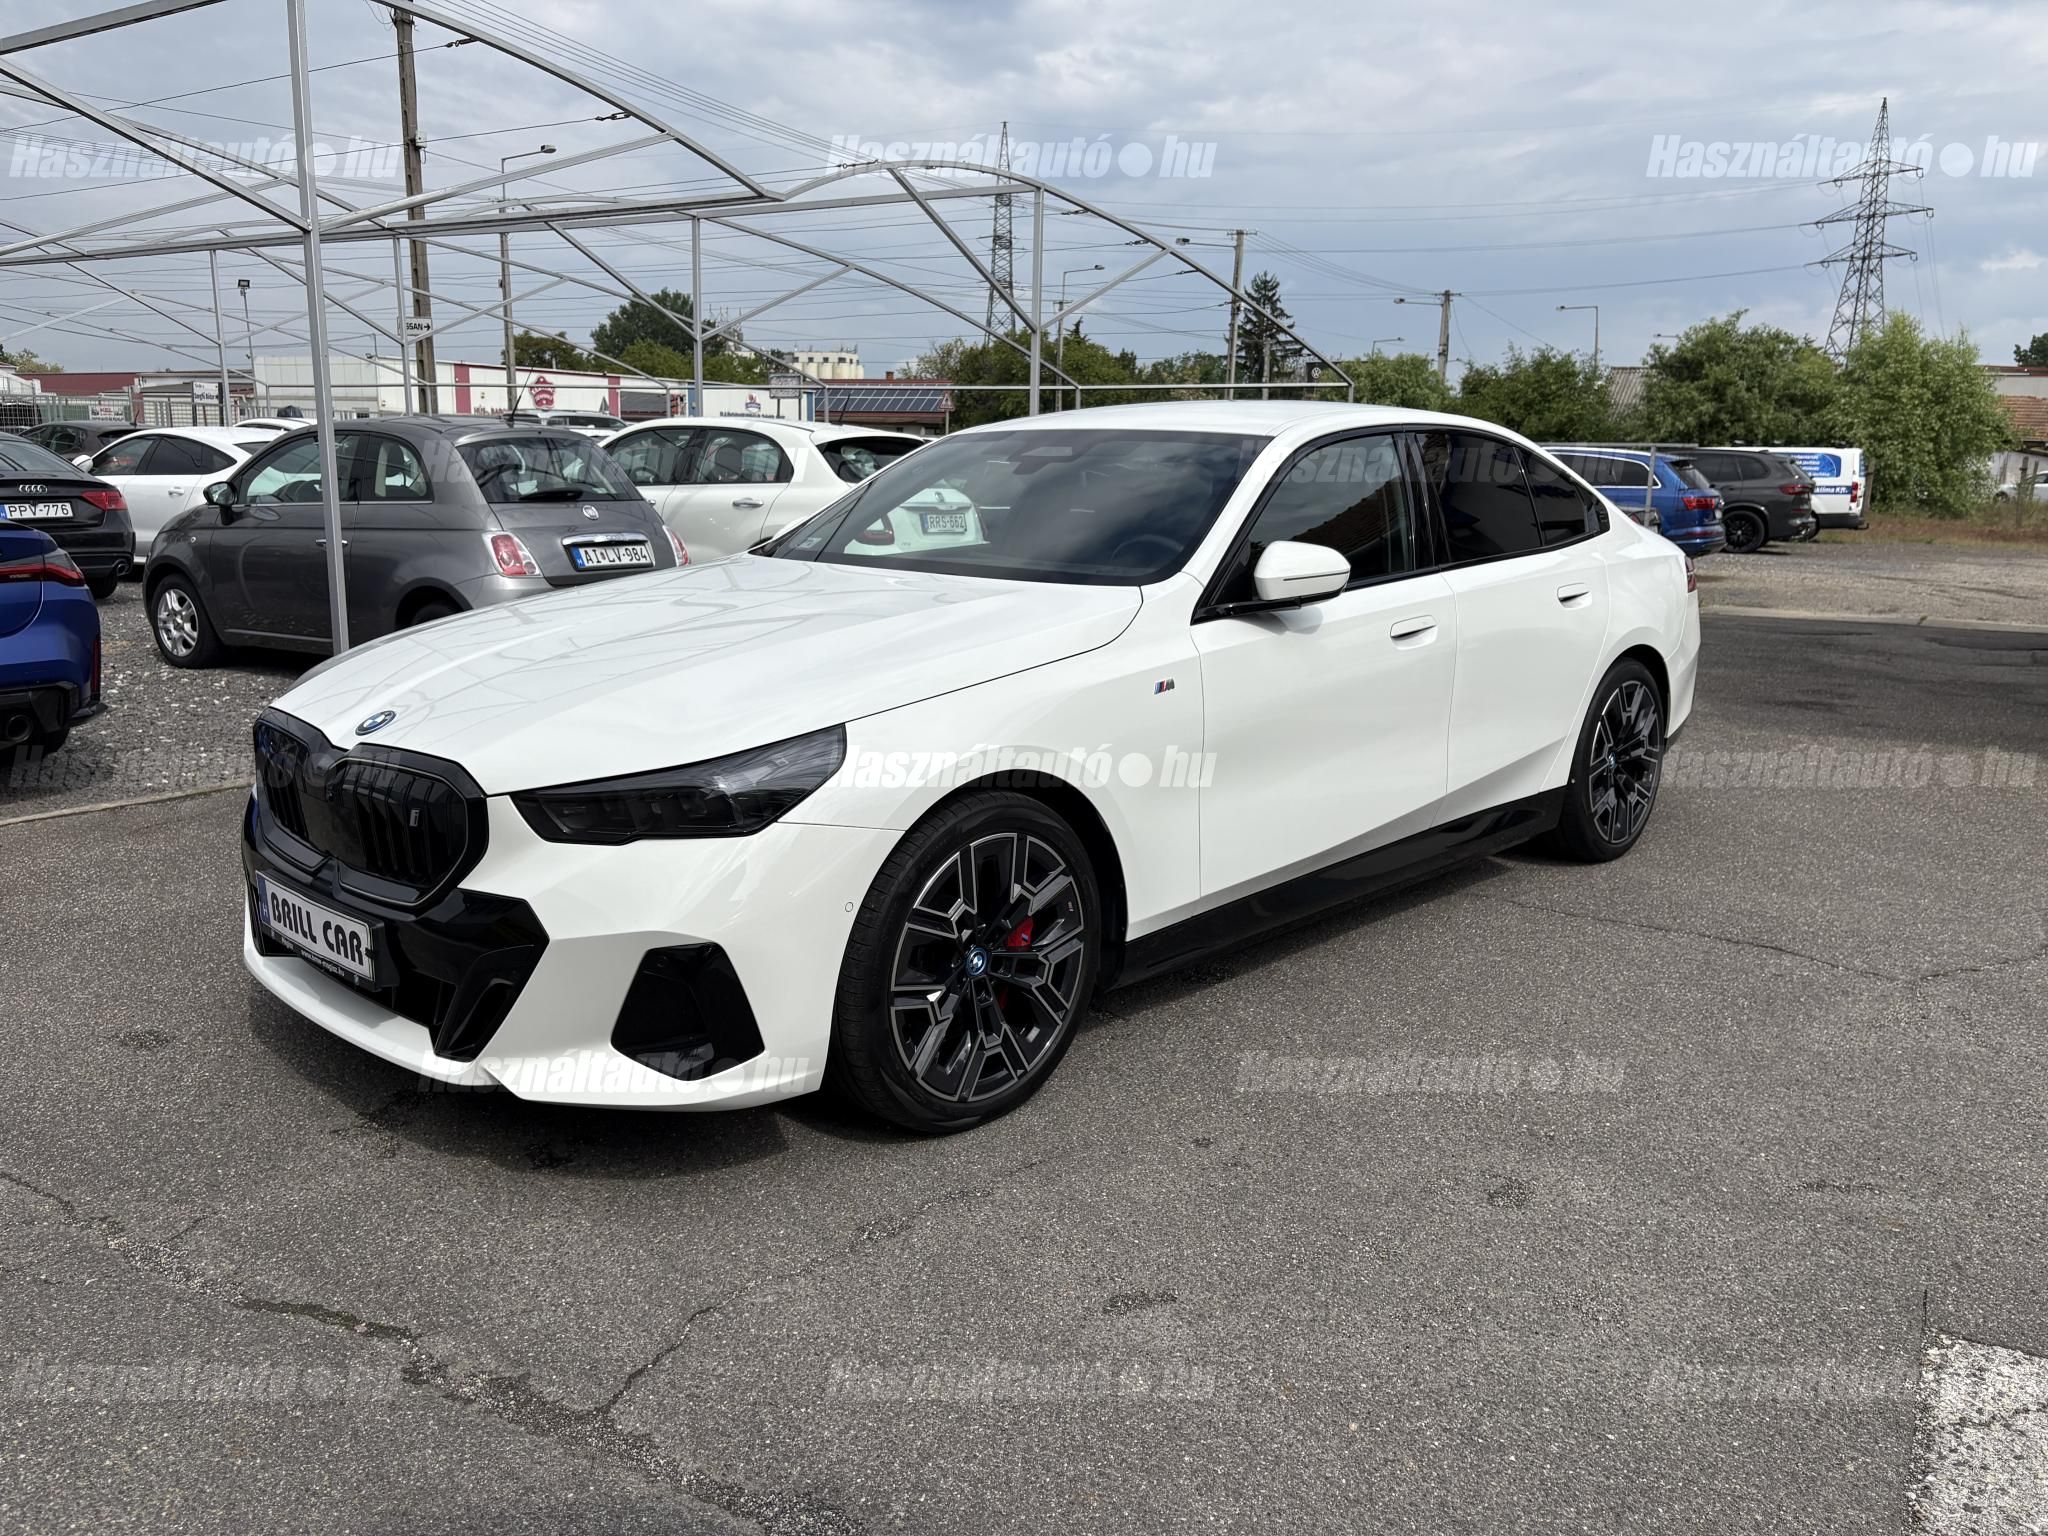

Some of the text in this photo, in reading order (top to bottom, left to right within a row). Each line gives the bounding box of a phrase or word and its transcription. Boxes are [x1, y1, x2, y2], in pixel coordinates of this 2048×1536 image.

[8, 504, 69, 518] PPV-776
[929, 515, 964, 529] RRS-662
[271, 892, 317, 944] BRILL
[322, 920, 364, 967] CAR
